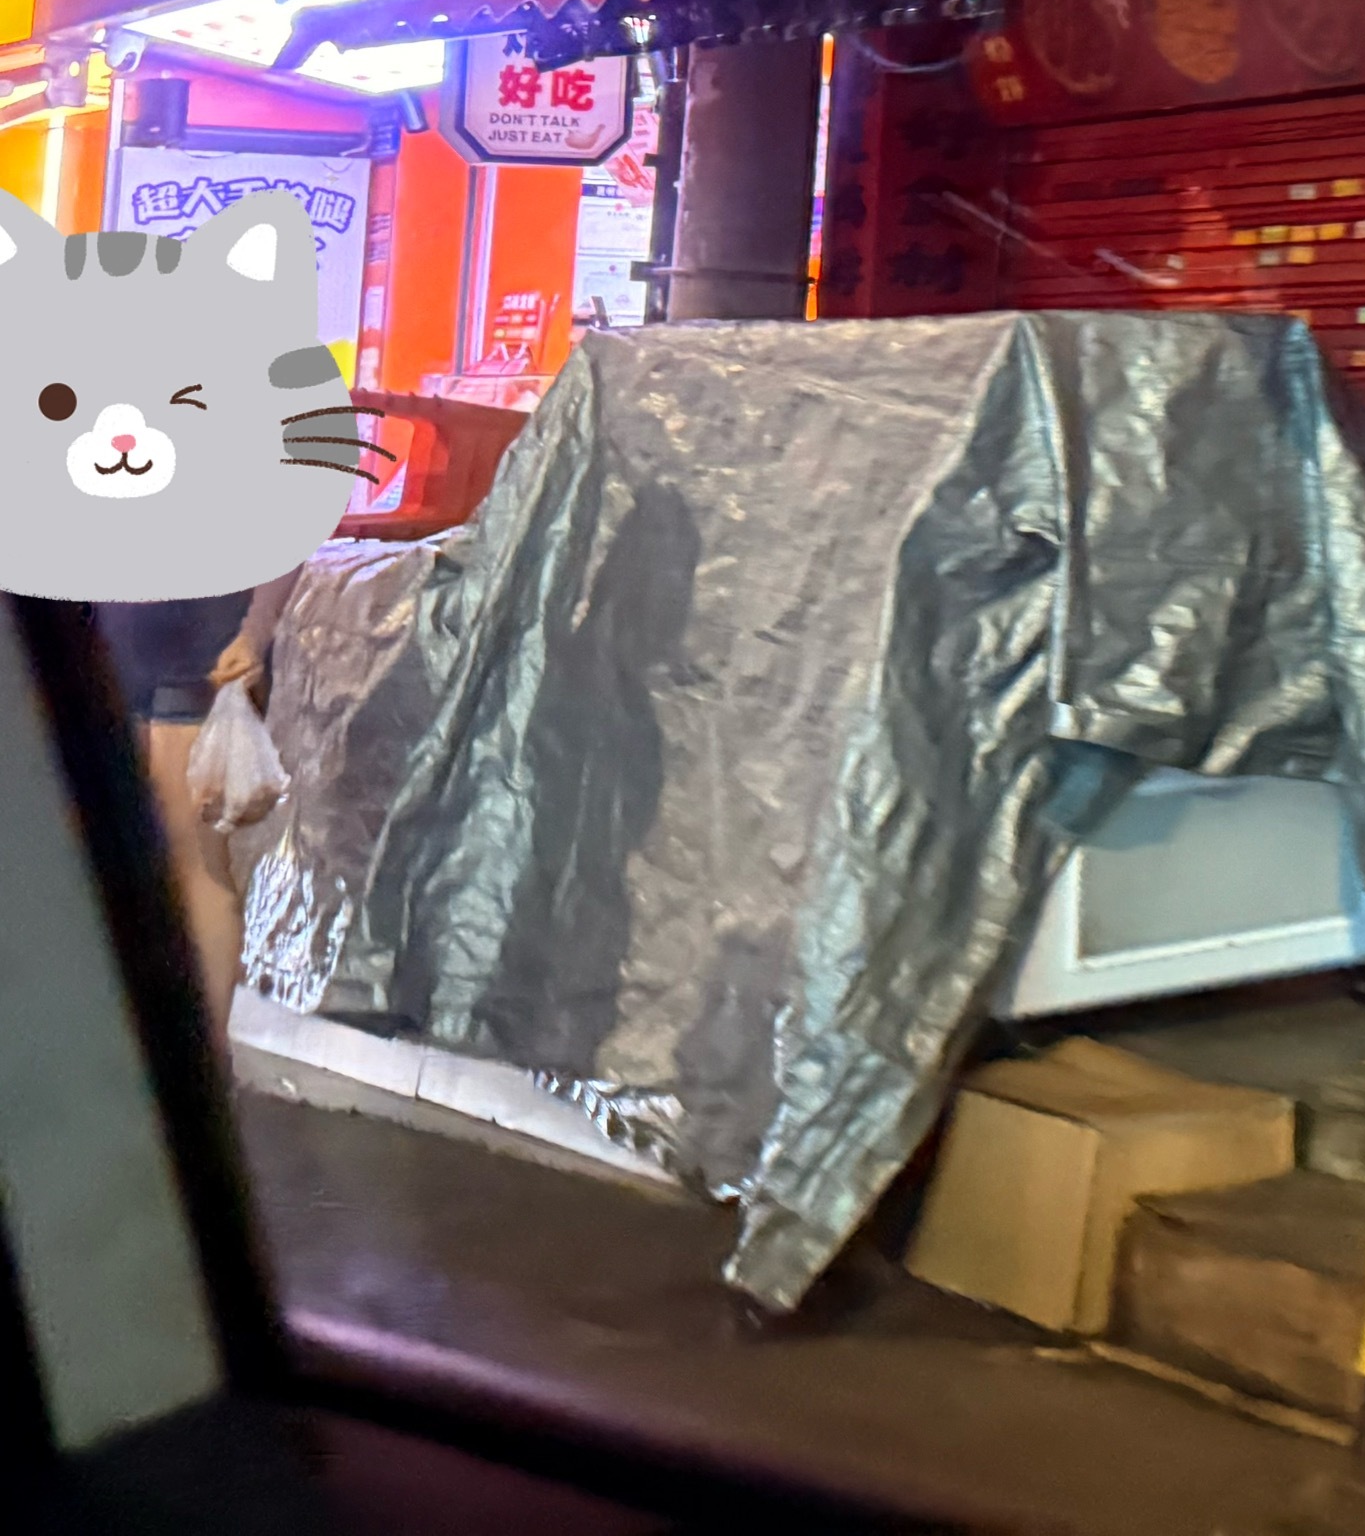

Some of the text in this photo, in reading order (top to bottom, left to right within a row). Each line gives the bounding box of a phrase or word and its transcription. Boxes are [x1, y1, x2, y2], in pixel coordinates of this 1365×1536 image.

[498, 64, 596, 112] 好吃
[540, 114, 581, 127] TALK
[488, 130, 564, 143] JUST EAT
